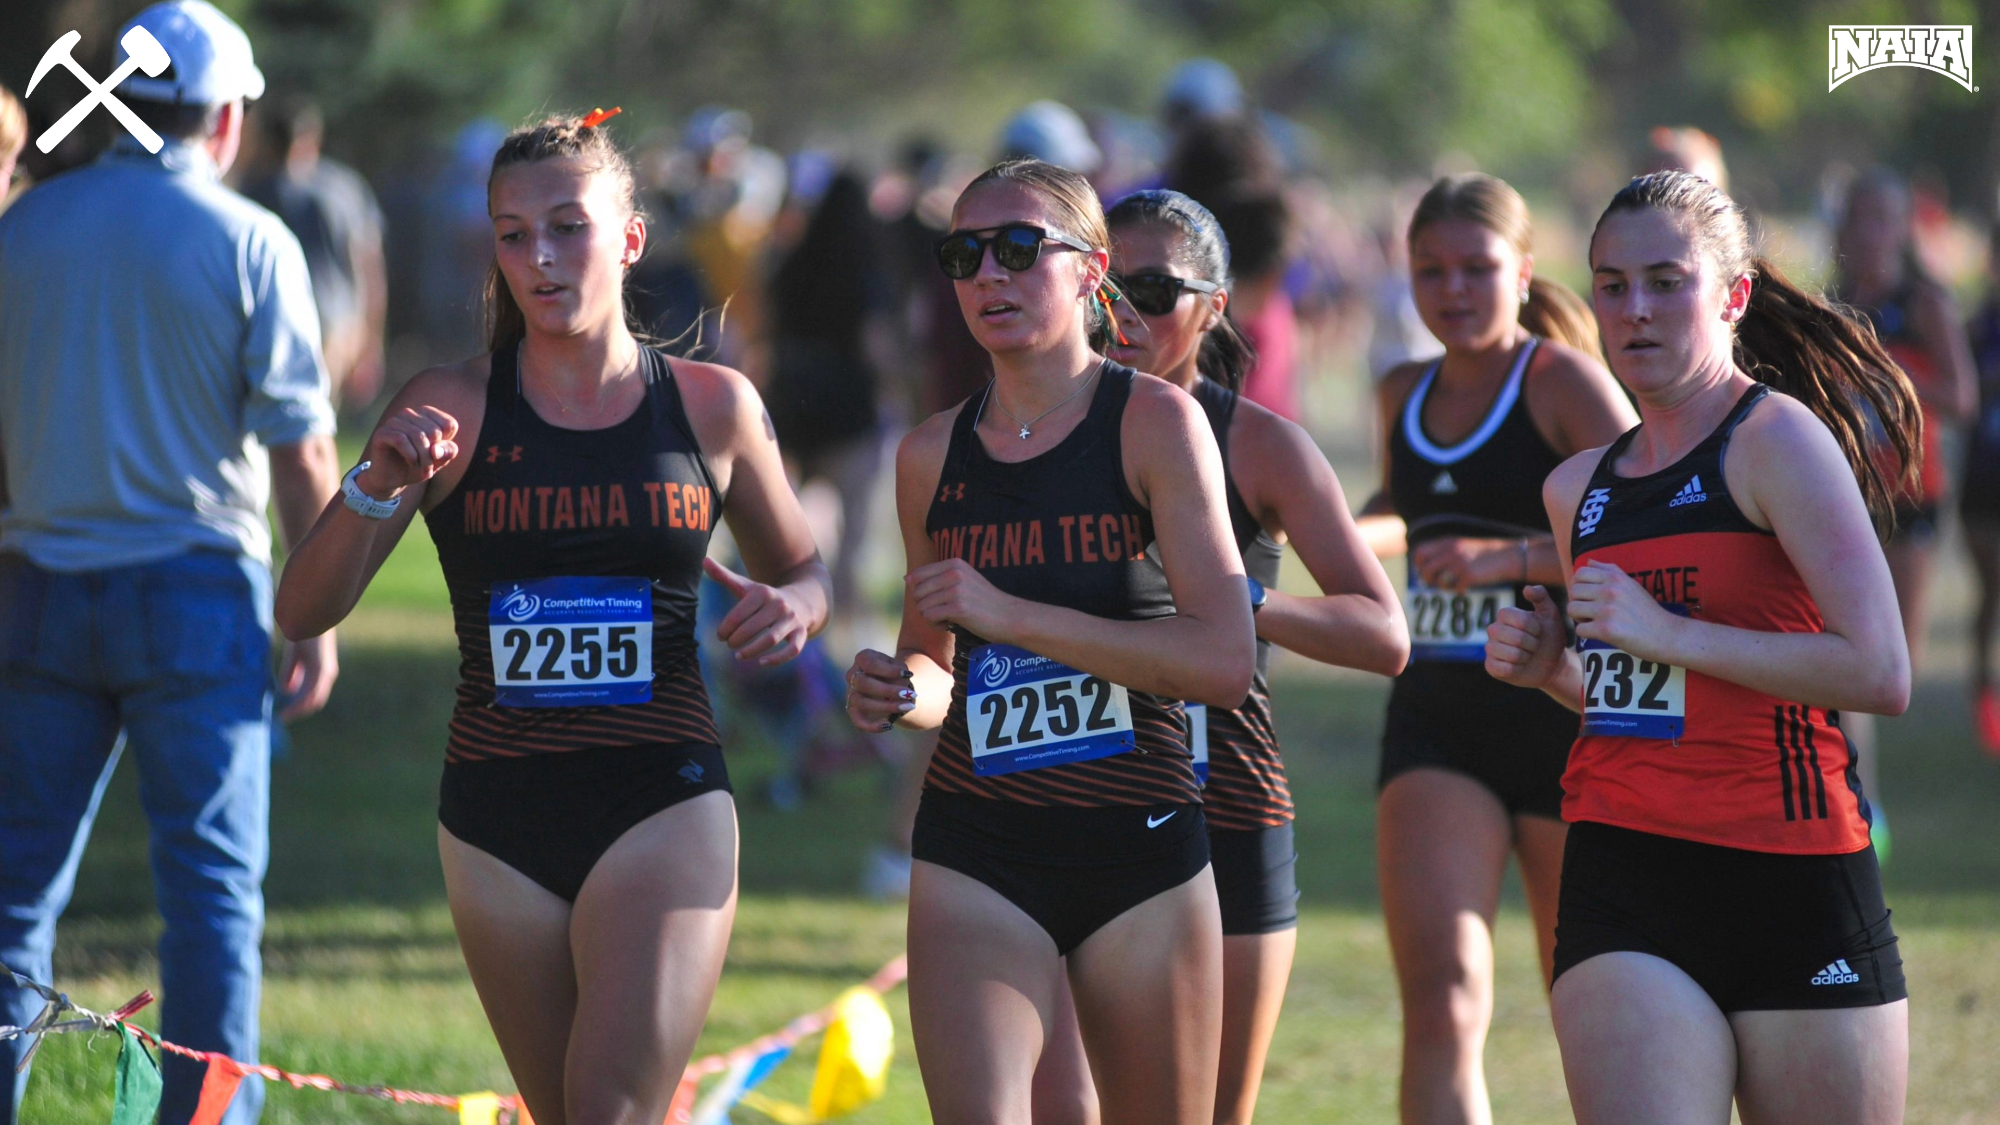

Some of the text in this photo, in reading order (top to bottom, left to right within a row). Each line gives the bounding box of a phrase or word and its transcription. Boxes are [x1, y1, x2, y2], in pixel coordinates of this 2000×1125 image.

[464, 482, 711, 535] MONTANA TECH
[1669, 493, 1707, 507] adidas
[1058, 514, 1145, 563] TECH
[503, 626, 638, 681] 2255
[980, 676, 1116, 750] 2252
[1014, 744, 1090, 762] www.CompetitiveTiming.com
[1811, 973, 1859, 985] adidas
